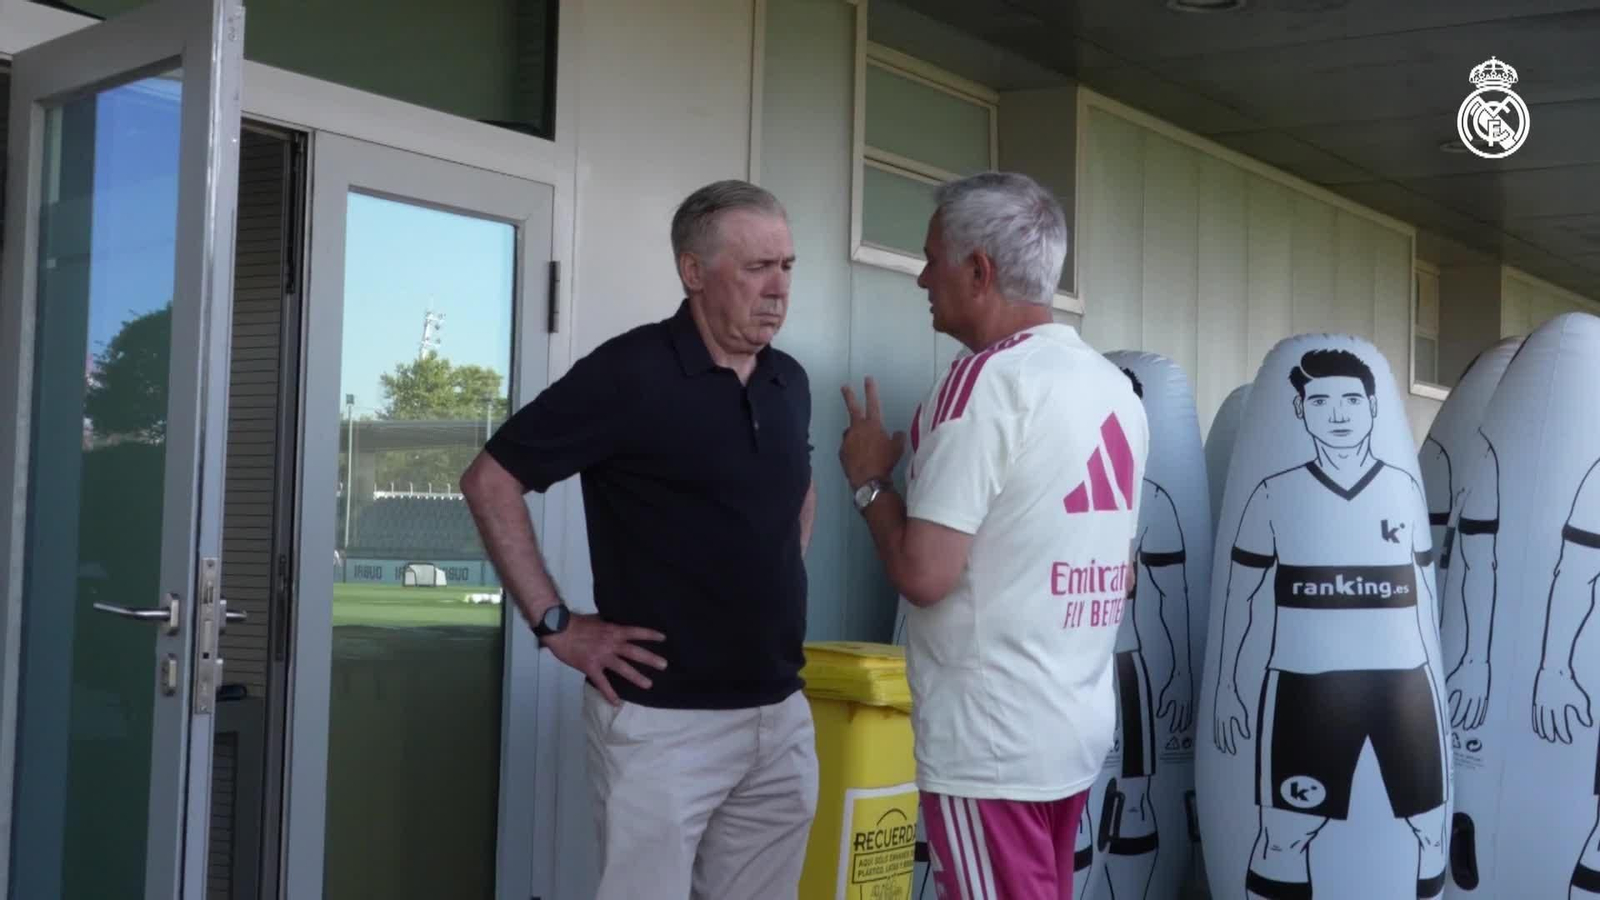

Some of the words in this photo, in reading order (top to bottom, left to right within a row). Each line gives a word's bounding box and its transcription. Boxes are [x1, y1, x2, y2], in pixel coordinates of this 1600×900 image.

[1051, 559, 1127, 596] Emirat
[1292, 573, 1410, 598] ranking.es
[1063, 601, 1085, 629] FLY
[1090, 599, 1124, 627] BETTE
